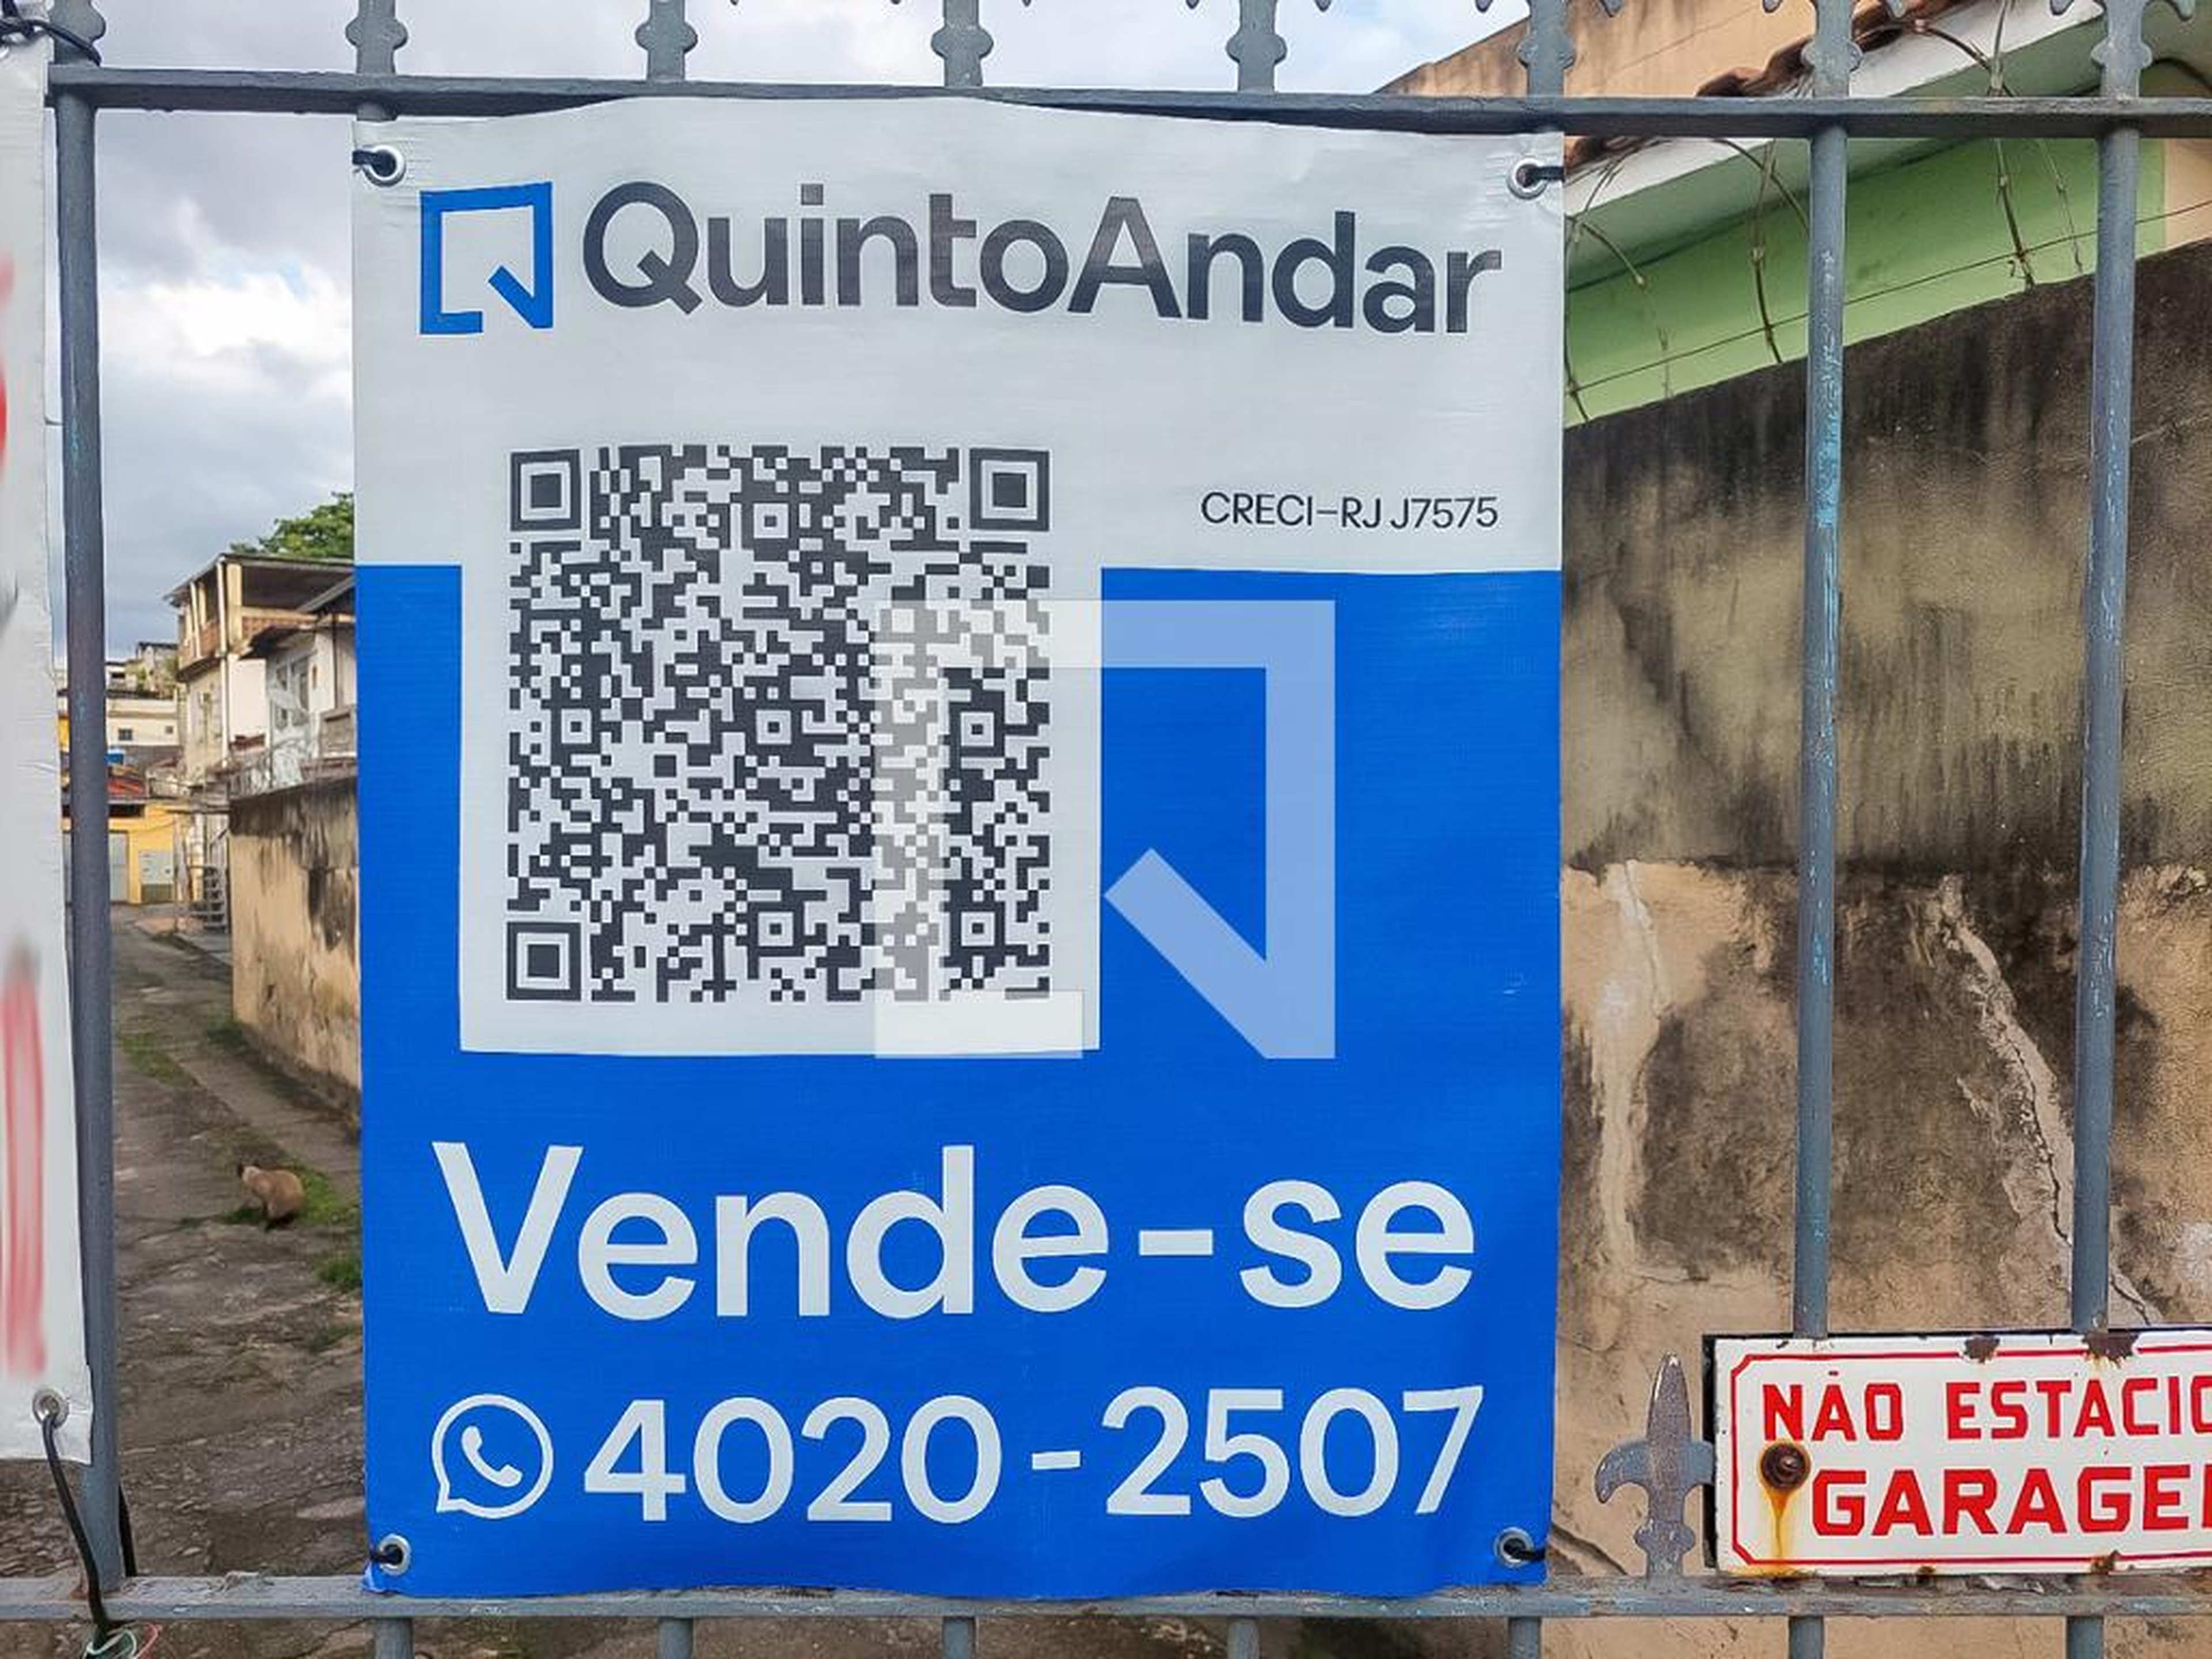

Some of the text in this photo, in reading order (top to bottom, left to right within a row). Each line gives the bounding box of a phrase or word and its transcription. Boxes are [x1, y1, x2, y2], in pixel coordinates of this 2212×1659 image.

[583, 181, 1502, 334] QuintoAndar
[1201, 492, 1498, 529] CRECI-RJ J7575
[432, 1142, 1474, 1320] Vende-se
[1762, 1370, 1903, 1441] NÃO
[1812, 1463, 2212, 1537] GARAGE
